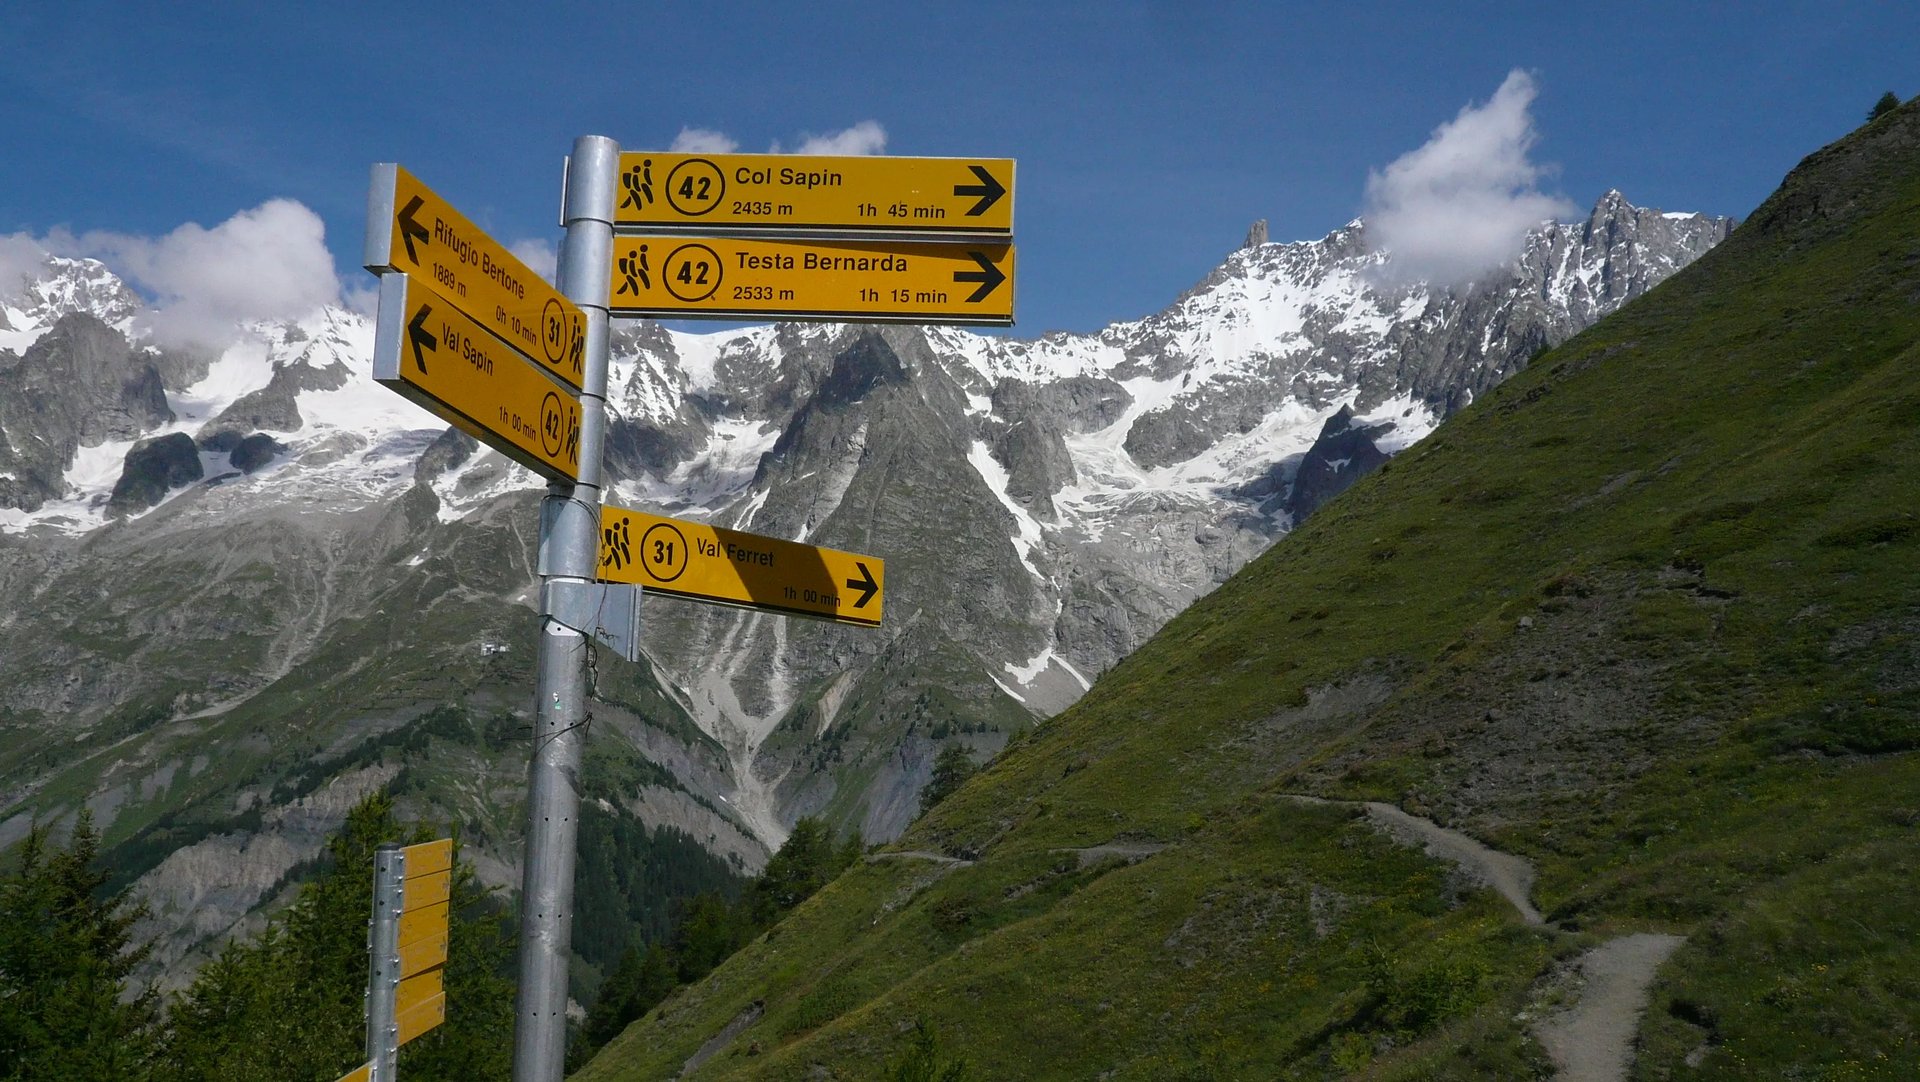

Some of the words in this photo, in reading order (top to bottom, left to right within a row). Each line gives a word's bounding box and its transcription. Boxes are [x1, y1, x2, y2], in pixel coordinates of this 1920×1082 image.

[678, 176, 711, 200] 42
[734, 167, 772, 185] Col
[780, 168, 842, 189] Sapin
[732, 201, 772, 216] 2435
[777, 204, 793, 216] m
[858, 204, 877, 217] 1h
[888, 204, 908, 218] 45
[913, 205, 945, 219] min
[434, 217, 478, 266] Rifugio
[482, 256, 525, 299] Bertone
[735, 252, 795, 270] Testa
[804, 253, 907, 272] Bernarda
[433, 262, 455, 291] 1889
[457, 283, 466, 297] m
[677, 261, 708, 285] 42
[733, 286, 773, 301] 2533
[778, 289, 795, 301] m
[859, 289, 878, 302] 1h
[891, 289, 909, 303] 15
[915, 290, 947, 304] min
[495, 305, 506, 325] 0h
[511, 316, 520, 335] 10
[522, 326, 537, 346] min
[548, 316, 560, 347] 31
[441, 322, 459, 352] Val
[463, 338, 493, 376] Sapin
[499, 406, 508, 424] 1h
[512, 412, 521, 432] 00
[523, 420, 536, 441] min
[545, 410, 558, 440] 42
[653, 540, 673, 566] 31
[697, 538, 720, 558] Val
[727, 544, 774, 567] Ferret
[783, 587, 796, 600] 1h
[803, 589, 817, 602] 00
[820, 593, 840, 607] min
